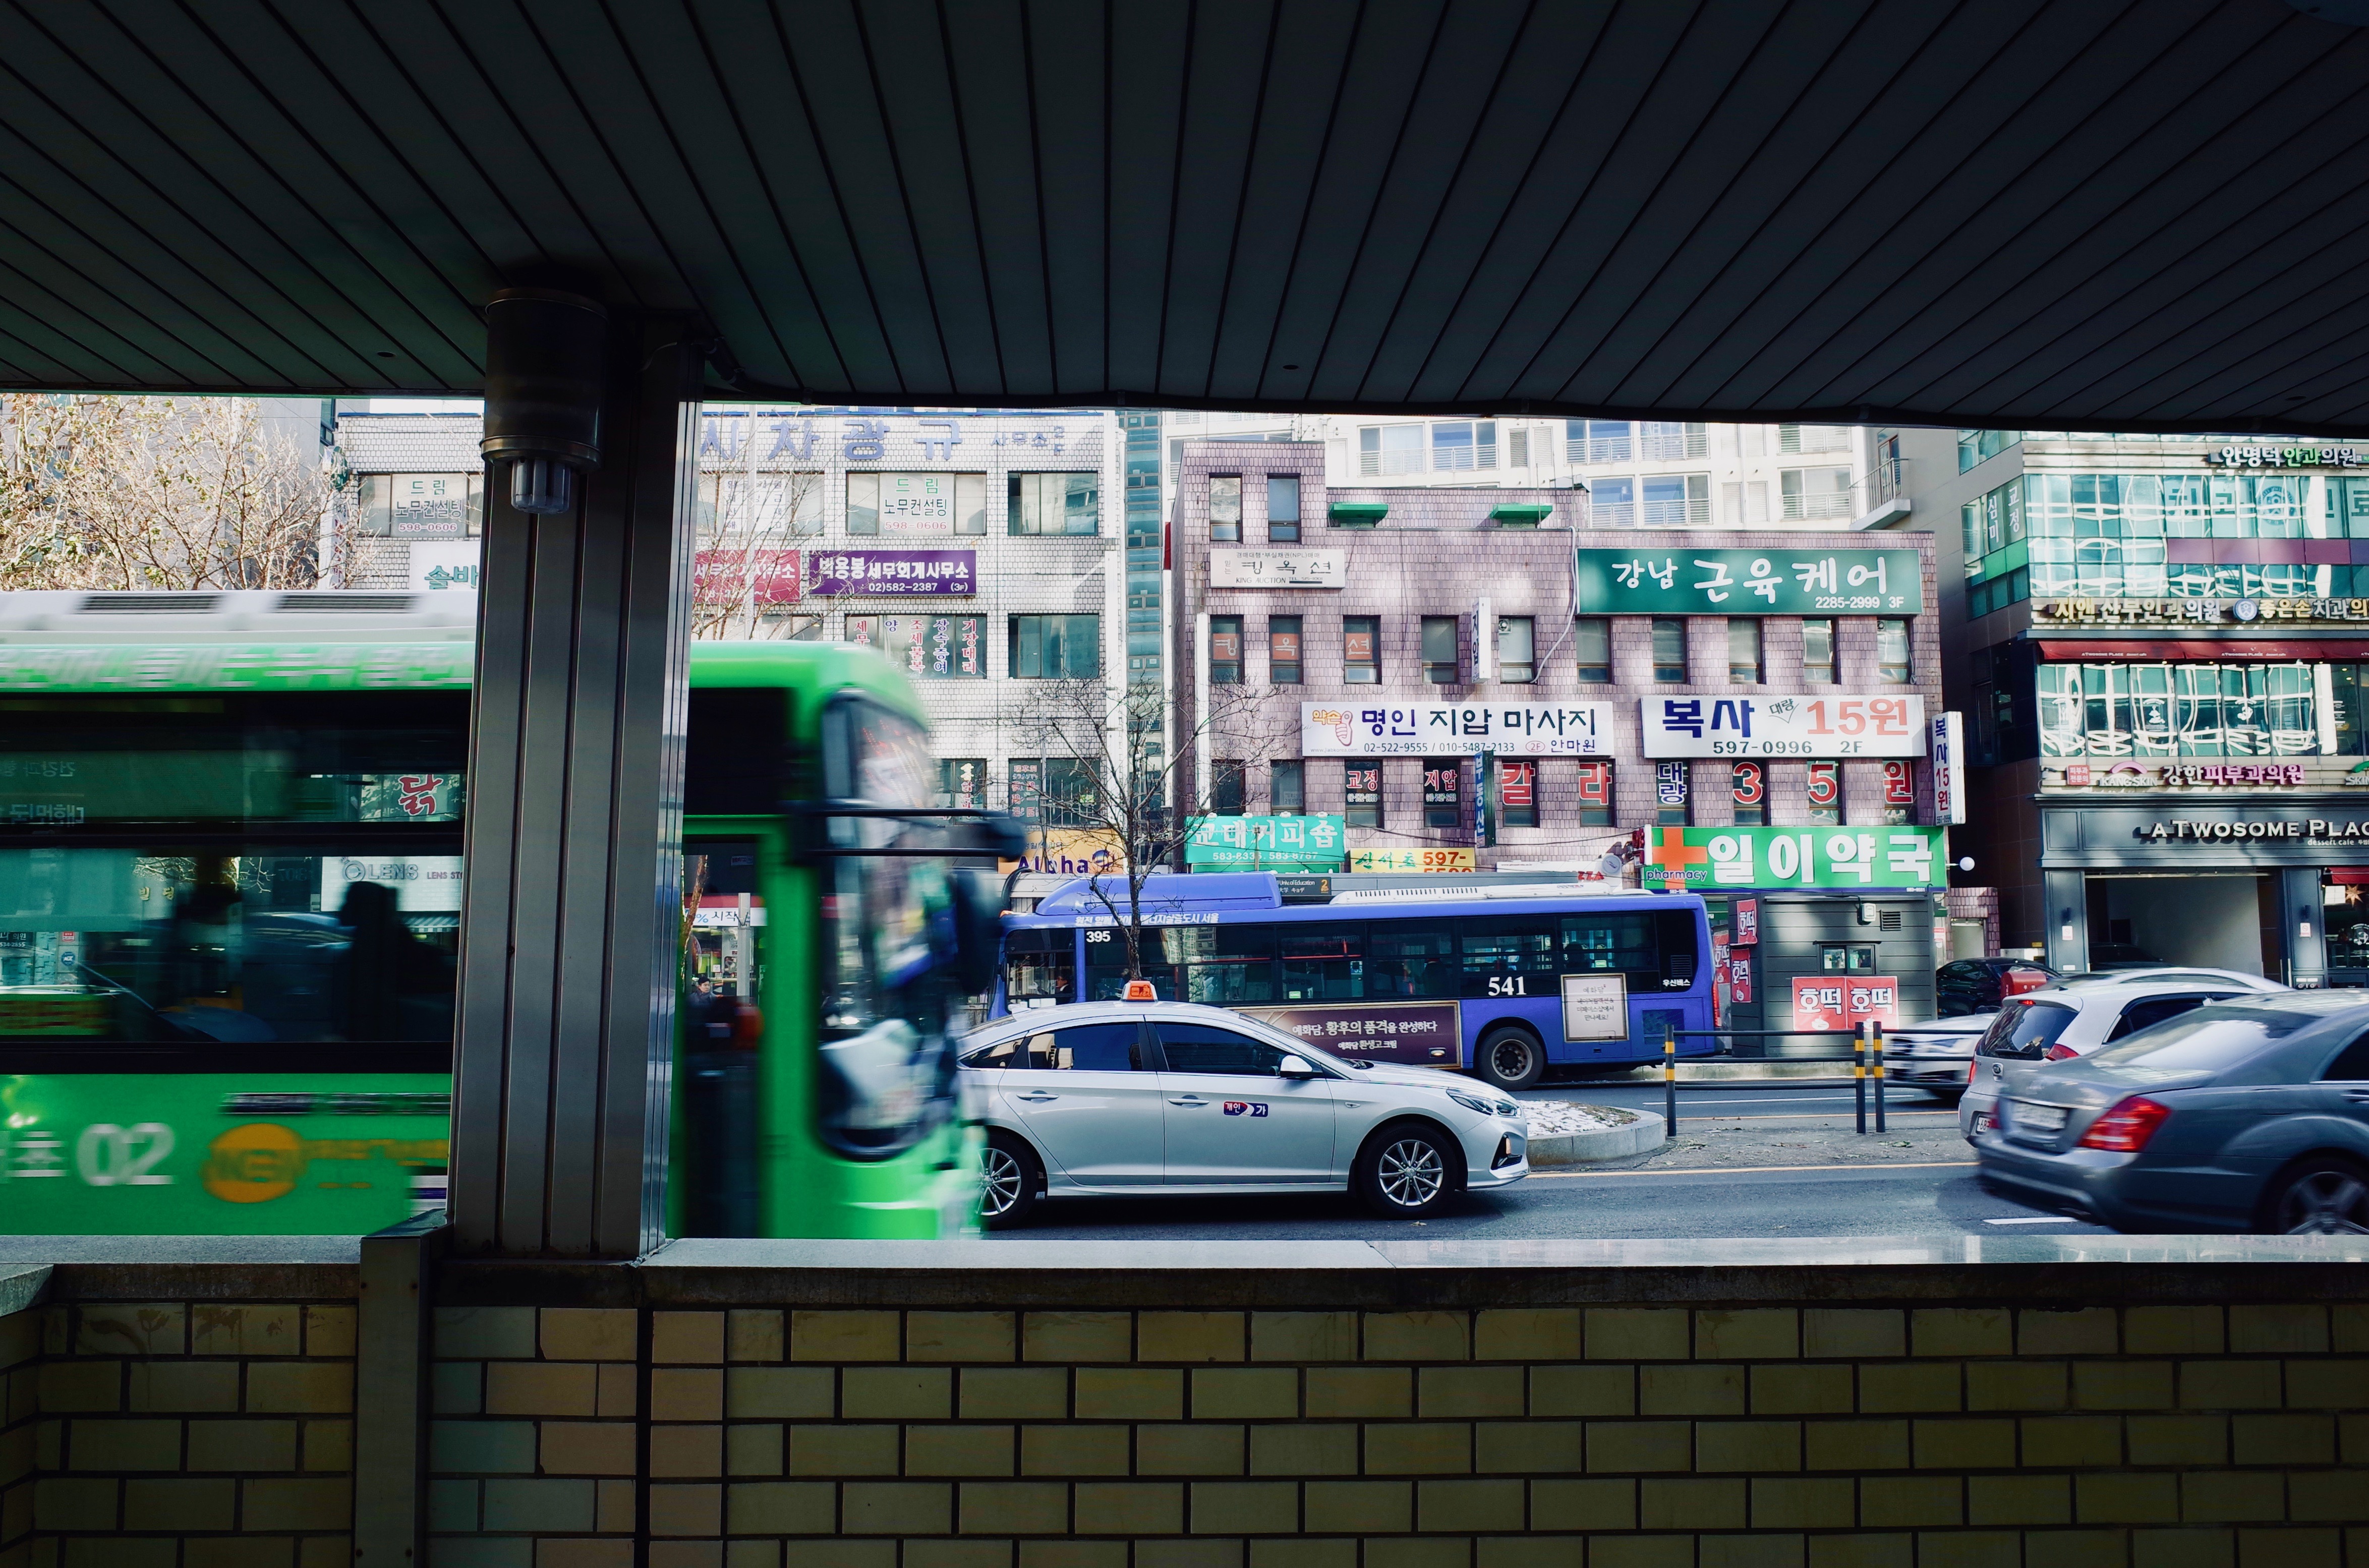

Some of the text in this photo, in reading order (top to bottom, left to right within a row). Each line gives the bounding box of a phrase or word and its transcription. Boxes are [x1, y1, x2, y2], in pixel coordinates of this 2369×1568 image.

[991, 432, 1047, 447] 사무소
[411, 480, 445, 495] 드림
[896, 478, 938, 494] 드림
[394, 499, 463, 518] 노무컨설팅
[884, 498, 947, 517] 노무컨설팅
[2008, 485, 2020, 533] 교정
[399, 523, 457, 532] 598-0606
[885, 521, 947, 531] 598-0606
[1987, 495, 1999, 543] 심미
[867, 561, 969, 579] 세무회계사무소
[1612, 559, 1678, 589] 강남
[869, 583, 968, 592] 02)582-2387 (3F)
[1815, 597, 1904, 608] 2285-2999 3F
[908, 619, 926, 674] 조세불복
[962, 619, 979, 675] 기장대리
[1215, 637, 1370, 656] 킹 옥 션
[1362, 709, 1595, 736] 명인 지압 마사지
[1662, 699, 1909, 738] 복사 대량 15원
[1364, 739, 1595, 752] 02-522-9555 010-5487-2133 2F 안마원
[1713, 741, 1863, 753] 597-0996 2F
[1935, 717, 1948, 764] 복사
[1346, 770, 1378, 791] 교정
[1424, 770, 1457, 791] 지압
[1501, 762, 1612, 805] 칼 라
[1657, 761, 1914, 804] 대량 3 5 원
[397, 774, 444, 816] 닭
[1476, 754, 1484, 834] 부동산
[2172, 820, 2300, 838] TWOSOME
[1018, 855, 1089, 874] Alpha
[1423, 851, 1466, 865] 597-
[1707, 834, 1932, 884] 일이약국
[427, 871, 447, 879] LENS
[1646, 868, 1708, 882] pharmacy
[1201, 913, 1219, 923] 서울
[1740, 911, 1755, 936] 호떡
[1086, 931, 1111, 943] 395
[1732, 960, 1749, 985] 호떡
[1488, 976, 1526, 996] 541
[1798, 988, 1841, 1015] 호떡
[1850, 988, 1893, 1015] 호떡
[1225, 1102, 1241, 1113] 개인
[1256, 1106, 1266, 1115] 가
